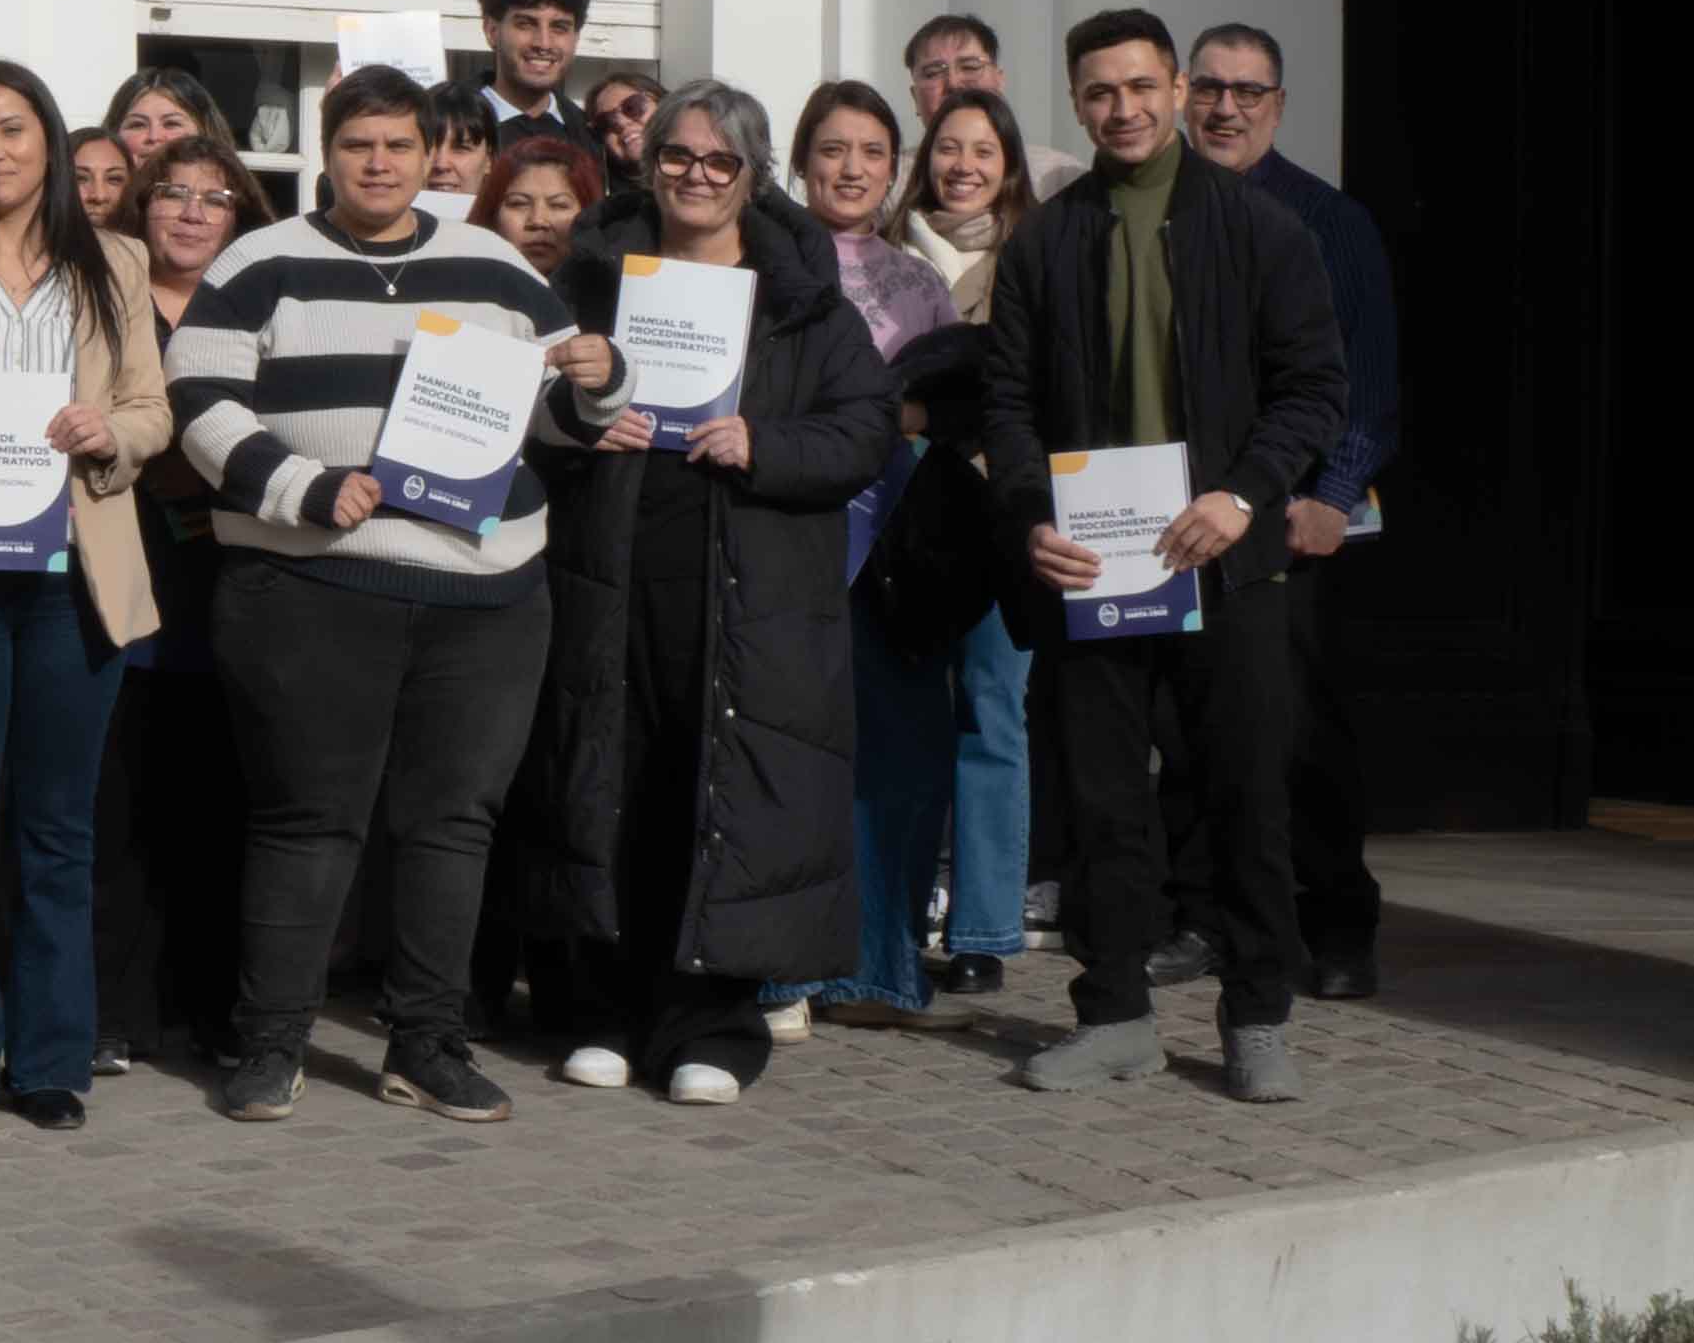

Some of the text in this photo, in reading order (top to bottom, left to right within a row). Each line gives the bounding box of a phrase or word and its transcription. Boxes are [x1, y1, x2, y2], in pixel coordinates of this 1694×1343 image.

[629, 314, 694, 329] MANUAL DE
[629, 326, 726, 345] PROCEDIMIENTOS
[627, 337, 727, 356] ADMINISTRATIVOS
[417, 372, 481, 400] MANUAL DE
[413, 384, 510, 421] PROCEDIMIENTOS
[409, 394, 509, 432] ADMINISTRATIVOS
[0, 434, 14, 442] DE
[1069, 508, 1135, 520] MANUAL DE
[1070, 516, 1170, 531] PROCEDIMIENTOS
